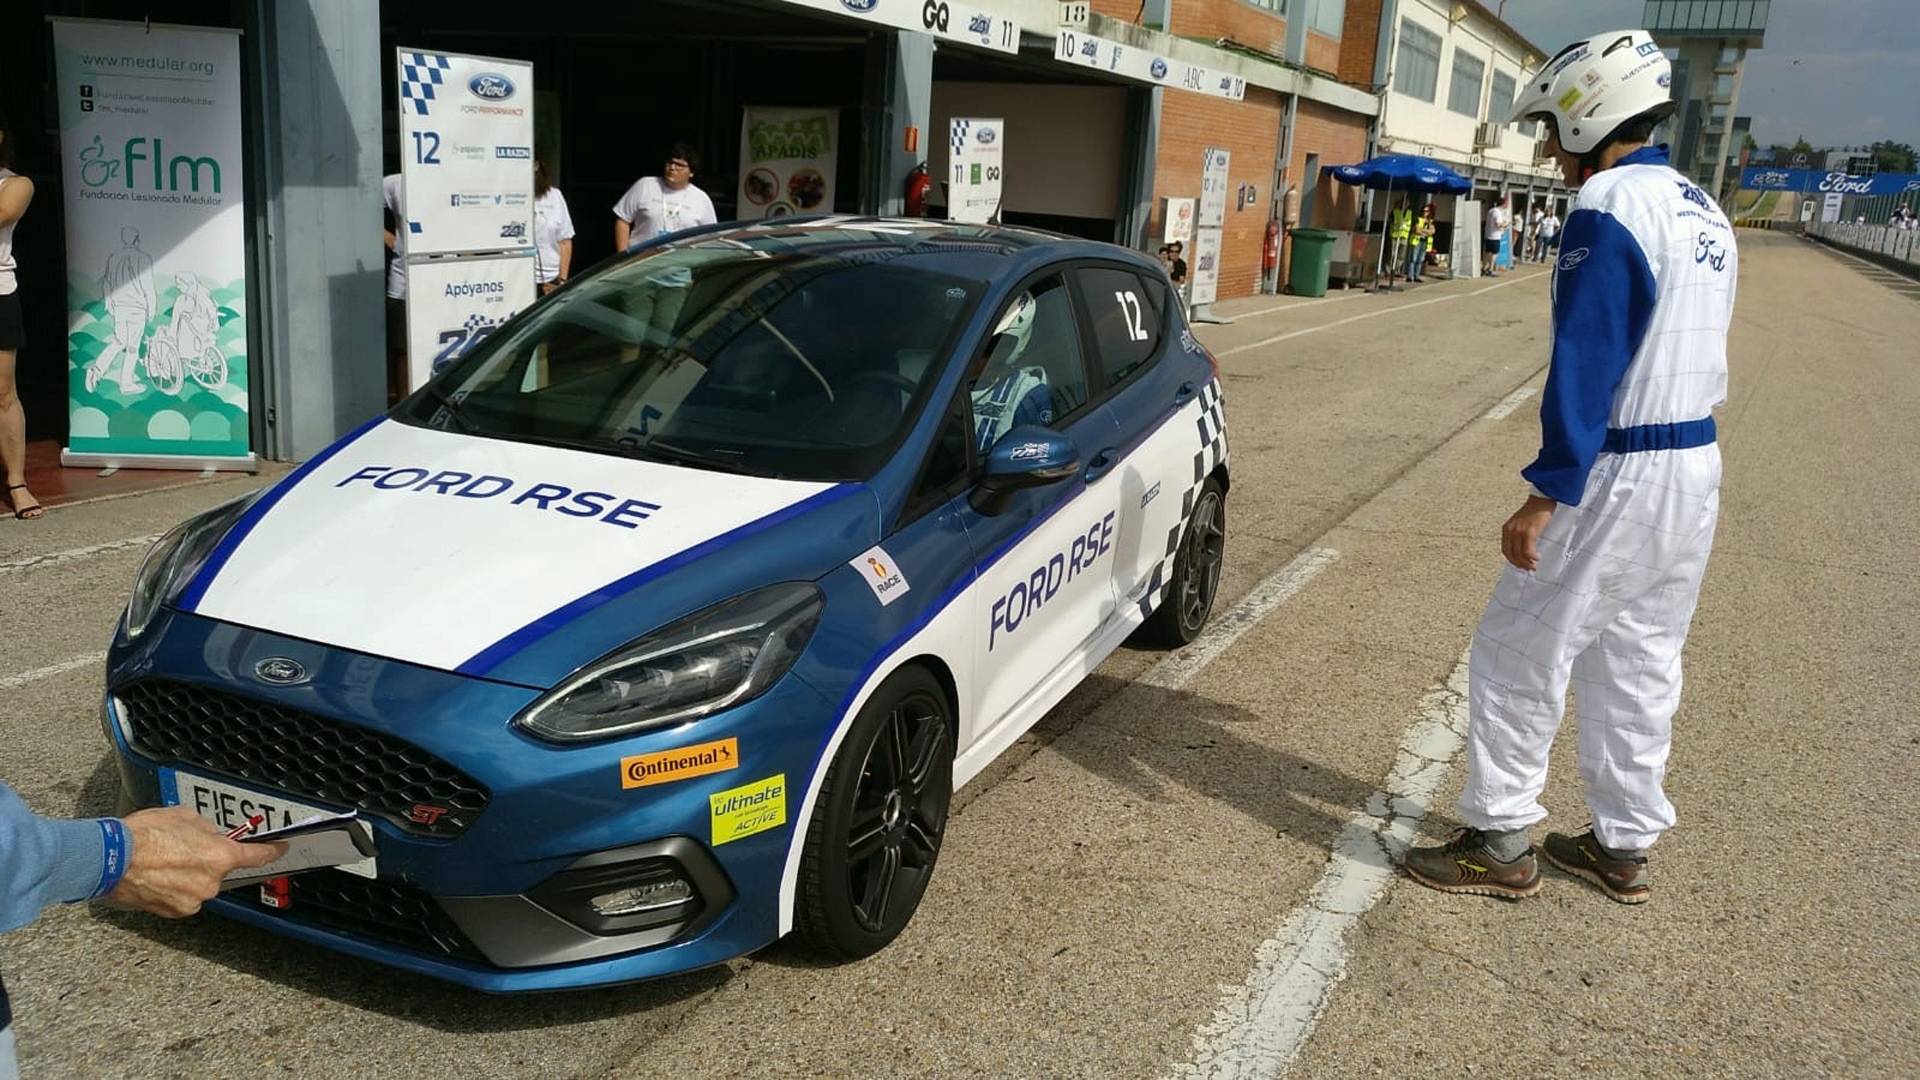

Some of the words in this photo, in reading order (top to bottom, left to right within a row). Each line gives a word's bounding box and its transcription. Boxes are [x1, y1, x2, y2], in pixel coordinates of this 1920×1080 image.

[1064, 4, 1085, 22] 18
[923, 1, 950, 33] GQ
[1002, 20, 1012, 48] 11
[1061, 32, 1075, 58] 10
[82, 54, 215, 76] www.medular.org
[478, 78, 508, 98] Ford
[412, 131, 441, 164] 12
[756, 144, 817, 160] APADIS
[124, 137, 222, 194] flm
[986, 166, 1001, 181] GQ
[1819, 172, 1874, 194] Ford
[445, 281, 504, 298] Apóyanos
[1115, 290, 1149, 342] 12
[335, 466, 514, 498] FORD
[511, 483, 662, 529] RSE
[877, 575, 902, 596] RACE
[989, 551, 1066, 652] FORD
[1066, 510, 1115, 584] RSE
[264, 661, 297, 678] Ford
[628, 749, 718, 781] Continental
[715, 785, 782, 817] ultimate
[411, 805, 448, 825] ST
[733, 810, 778, 833] ACTIVE
